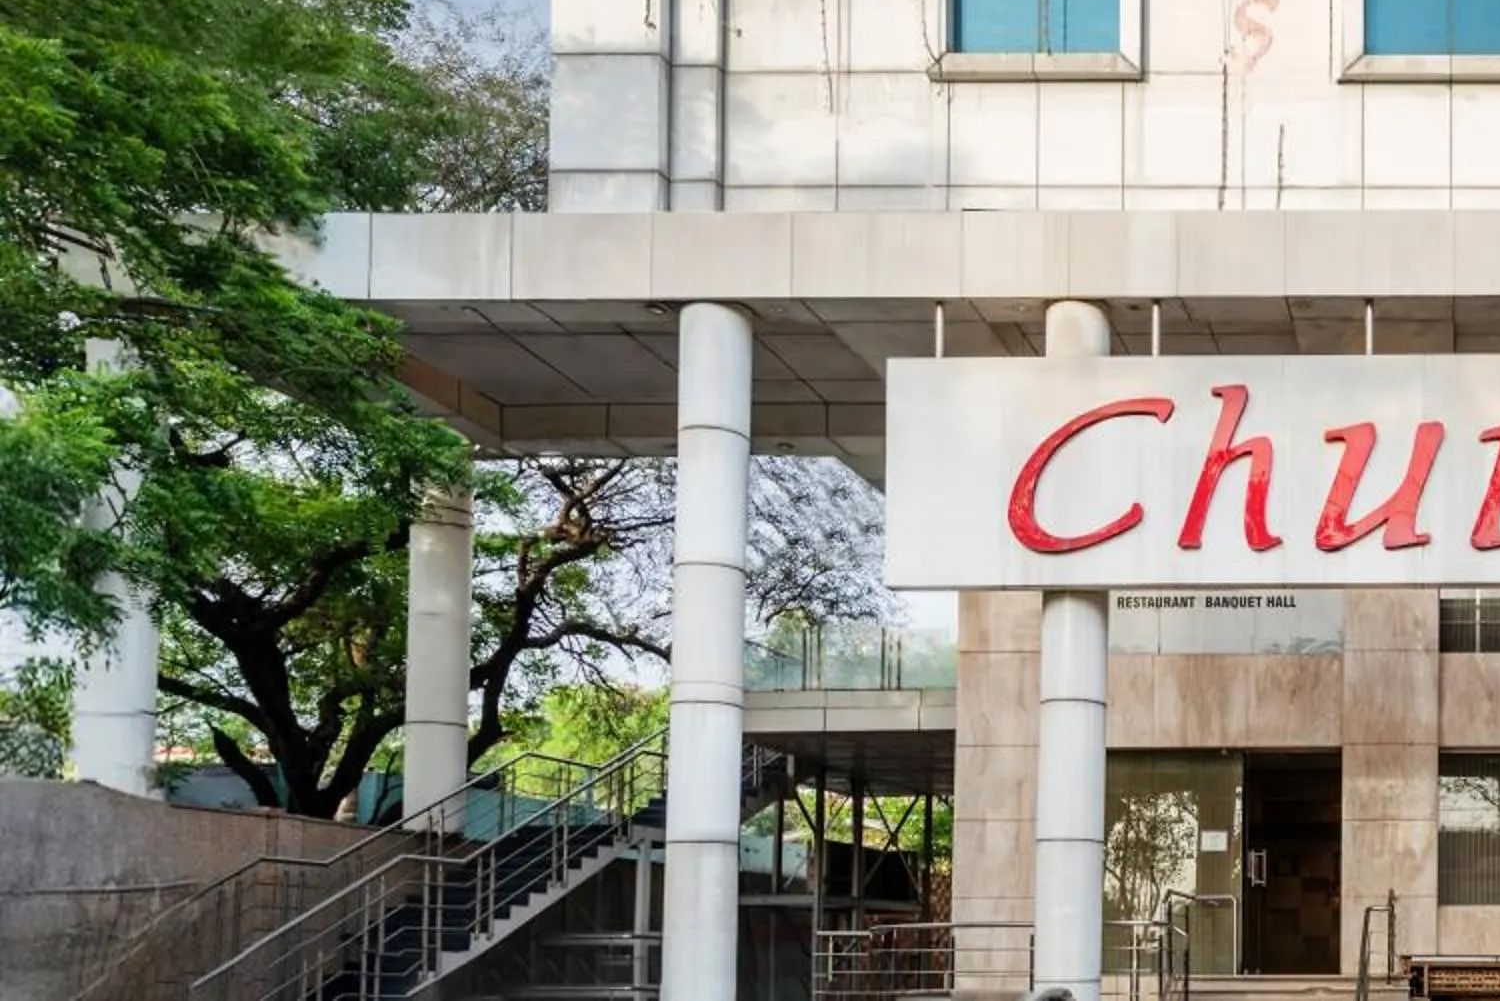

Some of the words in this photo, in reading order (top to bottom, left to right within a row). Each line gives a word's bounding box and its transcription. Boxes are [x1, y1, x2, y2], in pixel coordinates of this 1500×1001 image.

[1117, 596, 1195, 609] RESTAURANT
[1205, 596, 1262, 609] BANQUET
[1267, 596, 1297, 609] HALL
